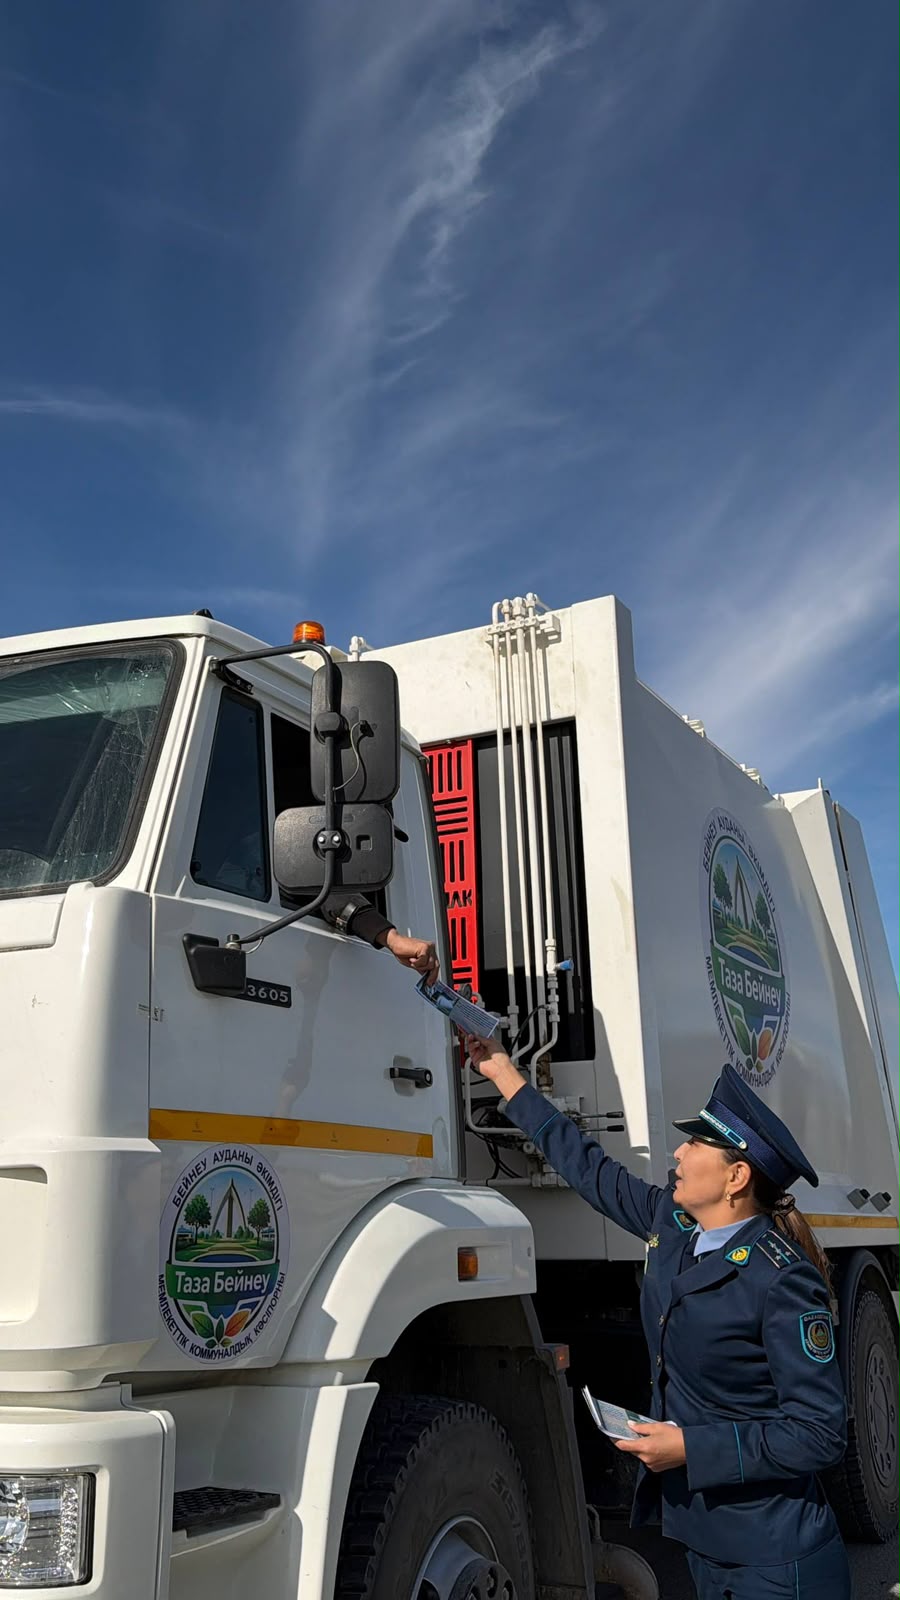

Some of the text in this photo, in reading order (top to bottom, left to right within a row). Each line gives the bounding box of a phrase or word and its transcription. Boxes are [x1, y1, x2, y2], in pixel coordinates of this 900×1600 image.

[241, 984, 289, 1003] 3605
[718, 957, 781, 1013] Таза Бейнеу
[172, 1149, 283, 1211] БЕЙНЕУ АУДАНЫ ӘКІМДІГІ
[175, 1269, 271, 1294] Таза Бейнеу
[158, 1272, 286, 1360] МЕМЛЕКЕТТІК КОММУНАЛДЫҚ КӘСІПОРНЫ
